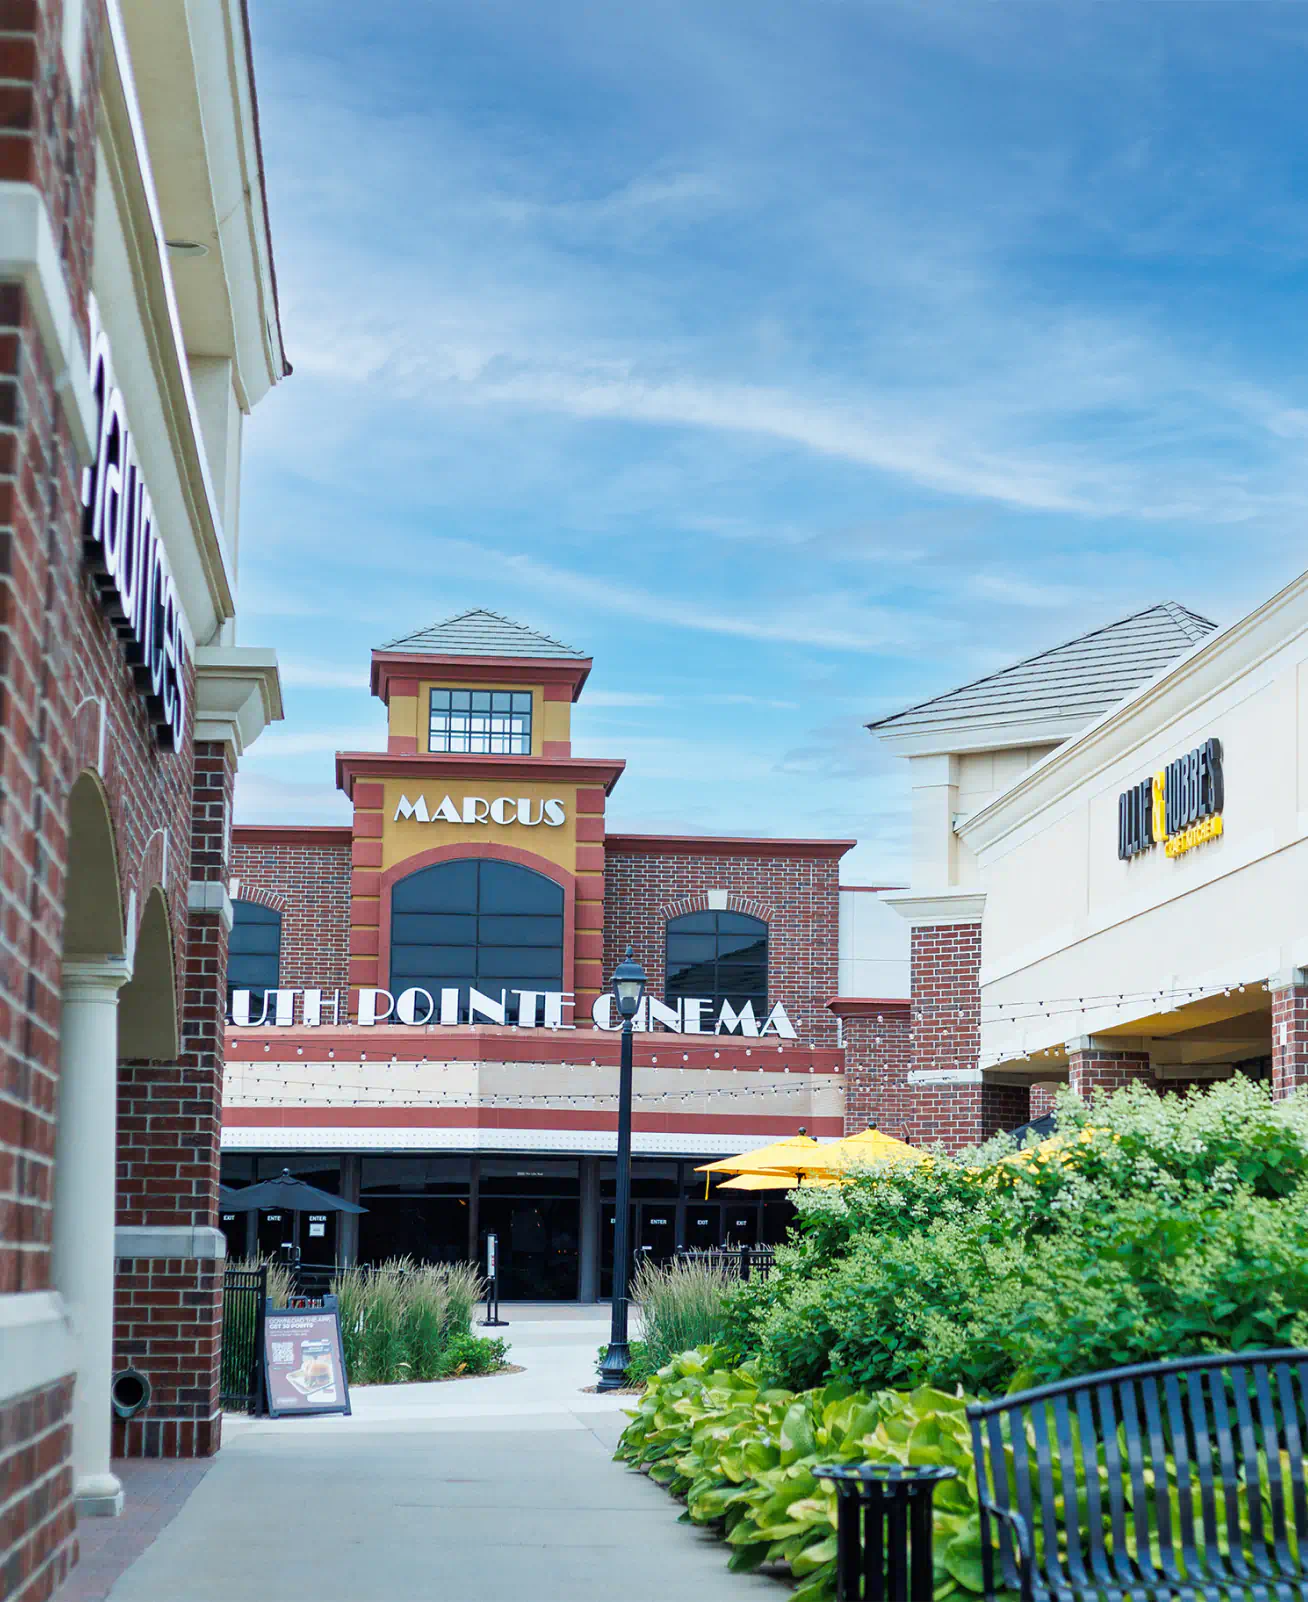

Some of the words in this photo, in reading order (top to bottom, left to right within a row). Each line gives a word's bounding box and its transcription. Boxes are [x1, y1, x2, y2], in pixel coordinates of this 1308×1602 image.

[394, 794, 566, 828] MARCUS
[1118, 777, 1154, 860] OLLIE
[1152, 771, 1168, 842] &
[1165, 738, 1224, 835] HOBBES
[224, 987, 340, 1027] UTH
[357, 987, 577, 1031] POINTE
[592, 993, 798, 1040] CINEMA
